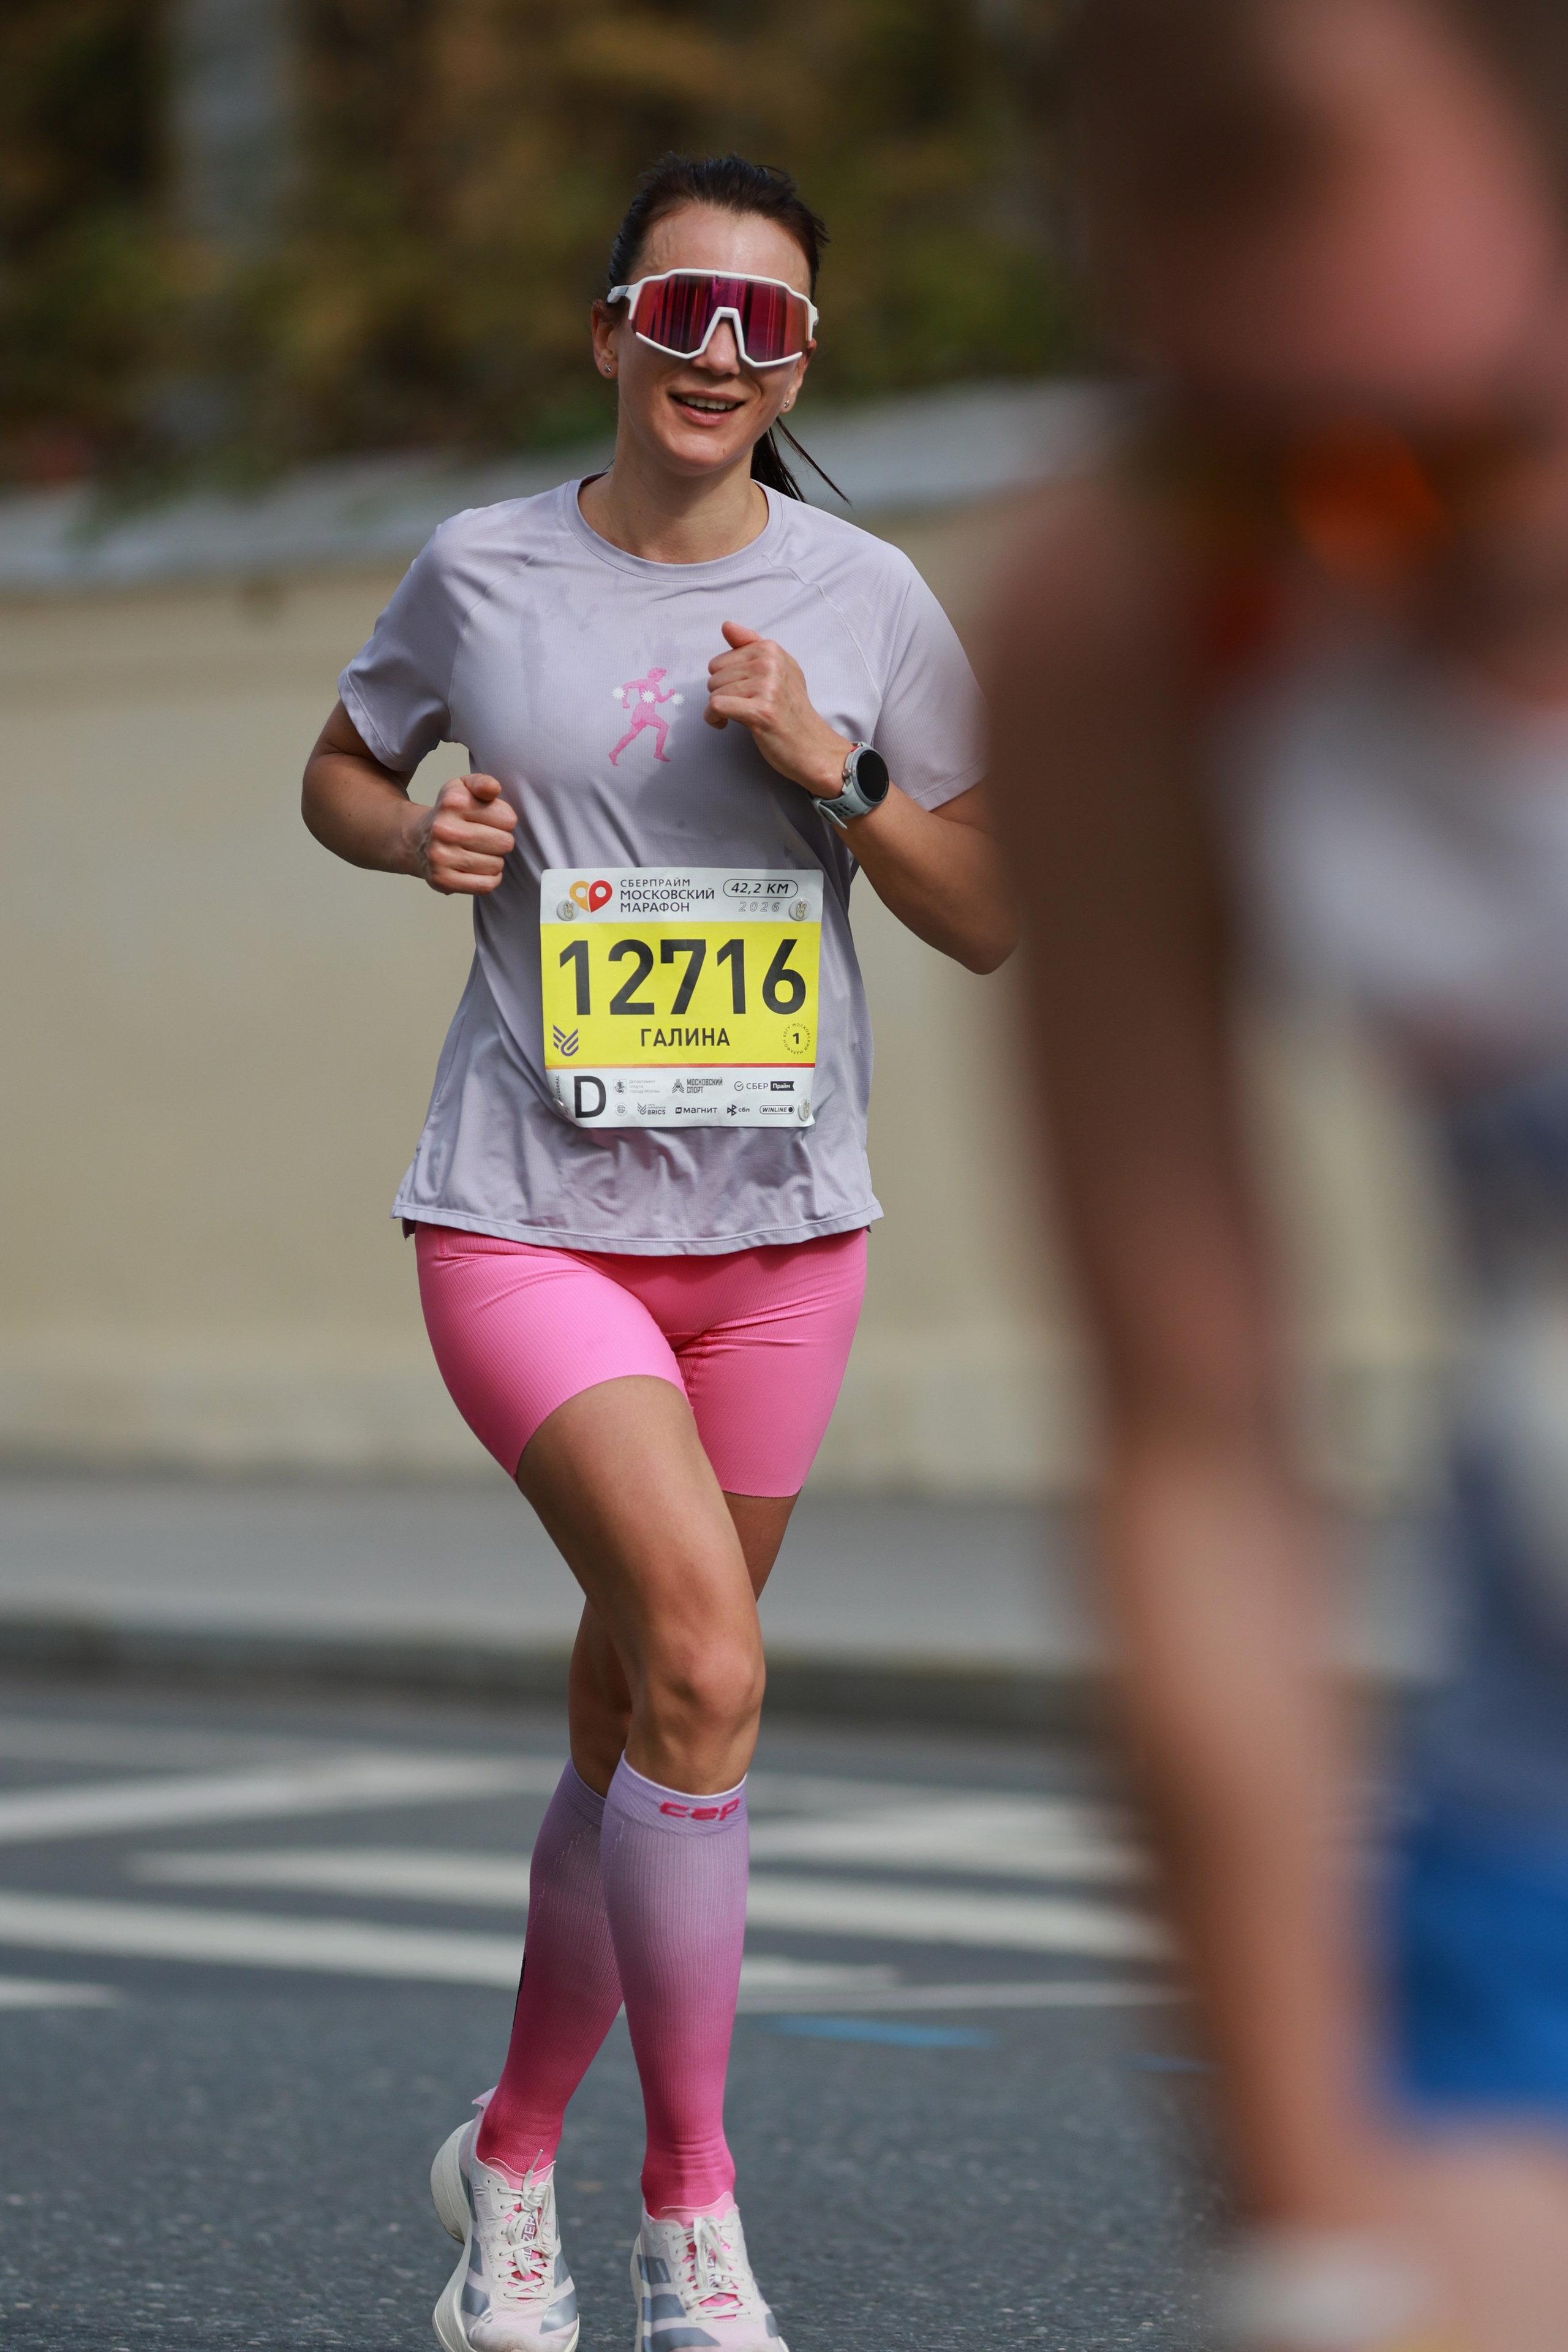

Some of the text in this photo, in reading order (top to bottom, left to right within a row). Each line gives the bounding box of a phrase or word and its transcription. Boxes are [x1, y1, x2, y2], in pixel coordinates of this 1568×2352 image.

[620, 877, 690, 888] СБЕРПРАЙМ
[620, 888, 714, 900] МОСКОВСКИЙ
[731, 883, 789, 894] 42,2 КМ
[620, 902, 690, 912] МАРАФОН
[739, 902, 780, 912] 2026
[559, 938, 807, 1016] 12716
[640, 1028, 730, 1047] ГАЛИНА
[793, 1033, 799, 1044] 1
[687, 1077, 723, 1086] МОСКОВСКИЙ
[574, 1076, 606, 1118] D
